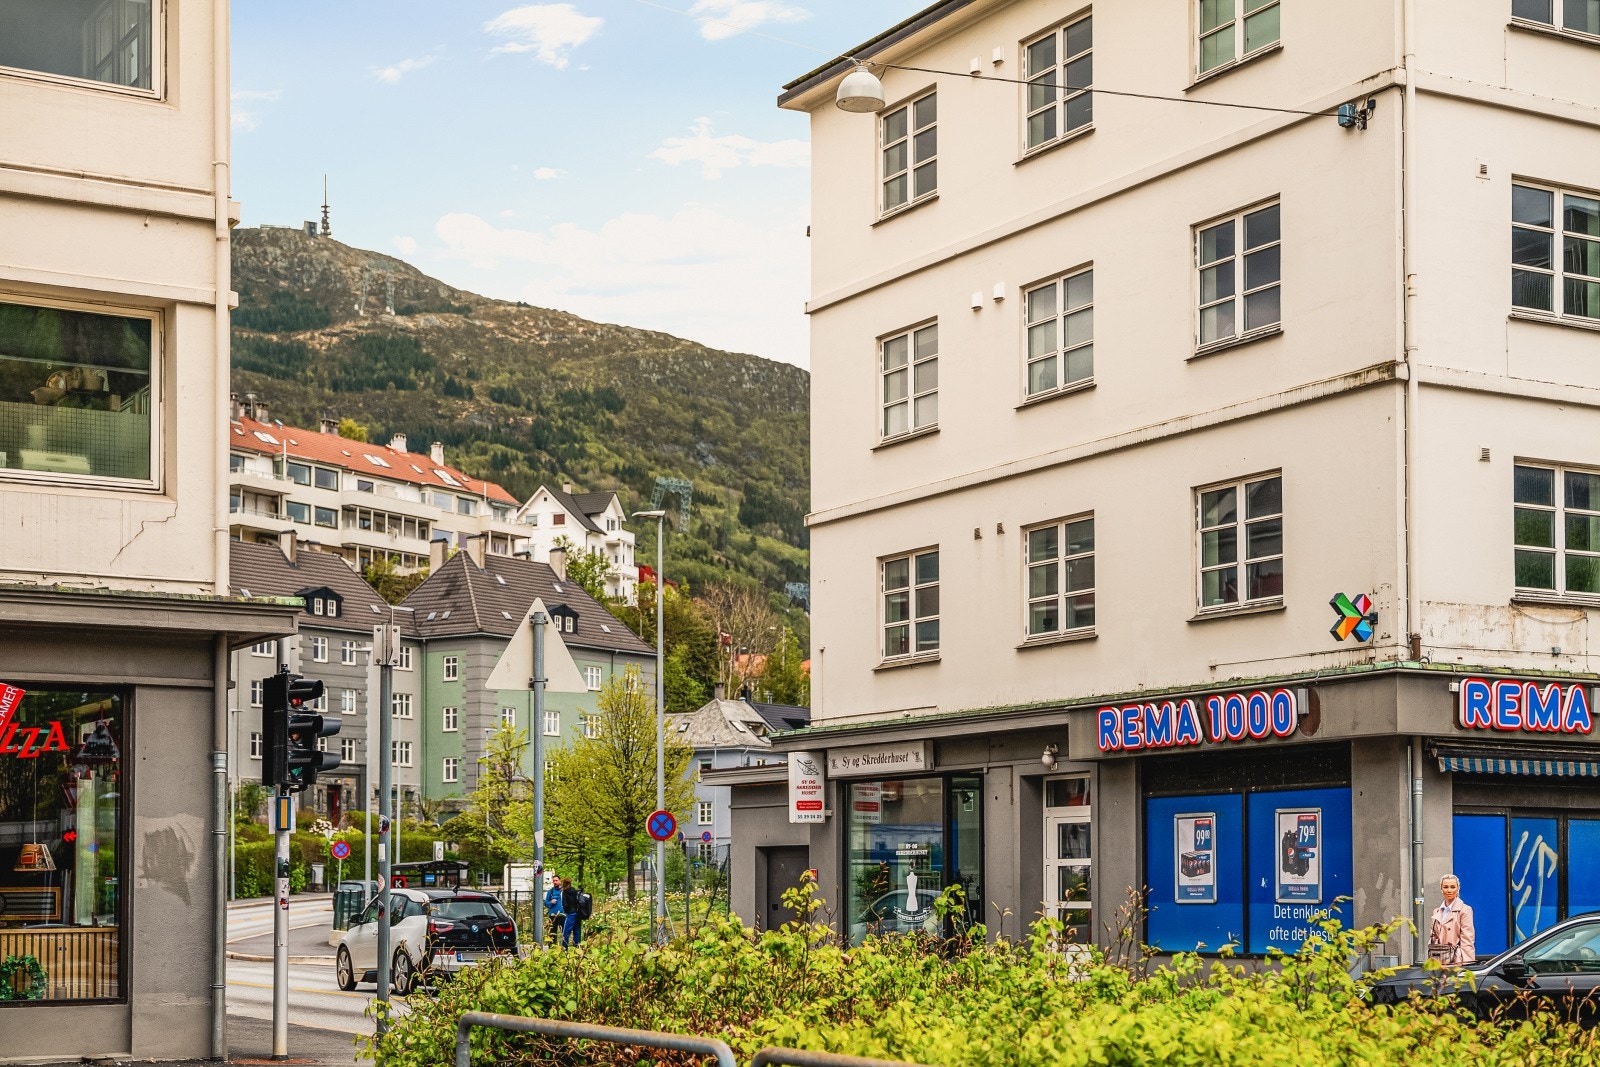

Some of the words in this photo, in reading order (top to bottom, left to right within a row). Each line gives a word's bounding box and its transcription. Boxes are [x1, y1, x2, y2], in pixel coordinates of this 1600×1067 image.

[1459, 677, 1593, 735] REMA
[1098, 699, 1202, 752] REMA
[1206, 688, 1296, 742] 1000
[842, 756, 851, 769] Sy
[852, 757, 860, 768] og
[862, 752, 909, 765] Skredderhuset
[1274, 904, 1292, 919] Det
[1269, 925, 1290, 941] ofte
[1291, 926, 1308, 941] det
